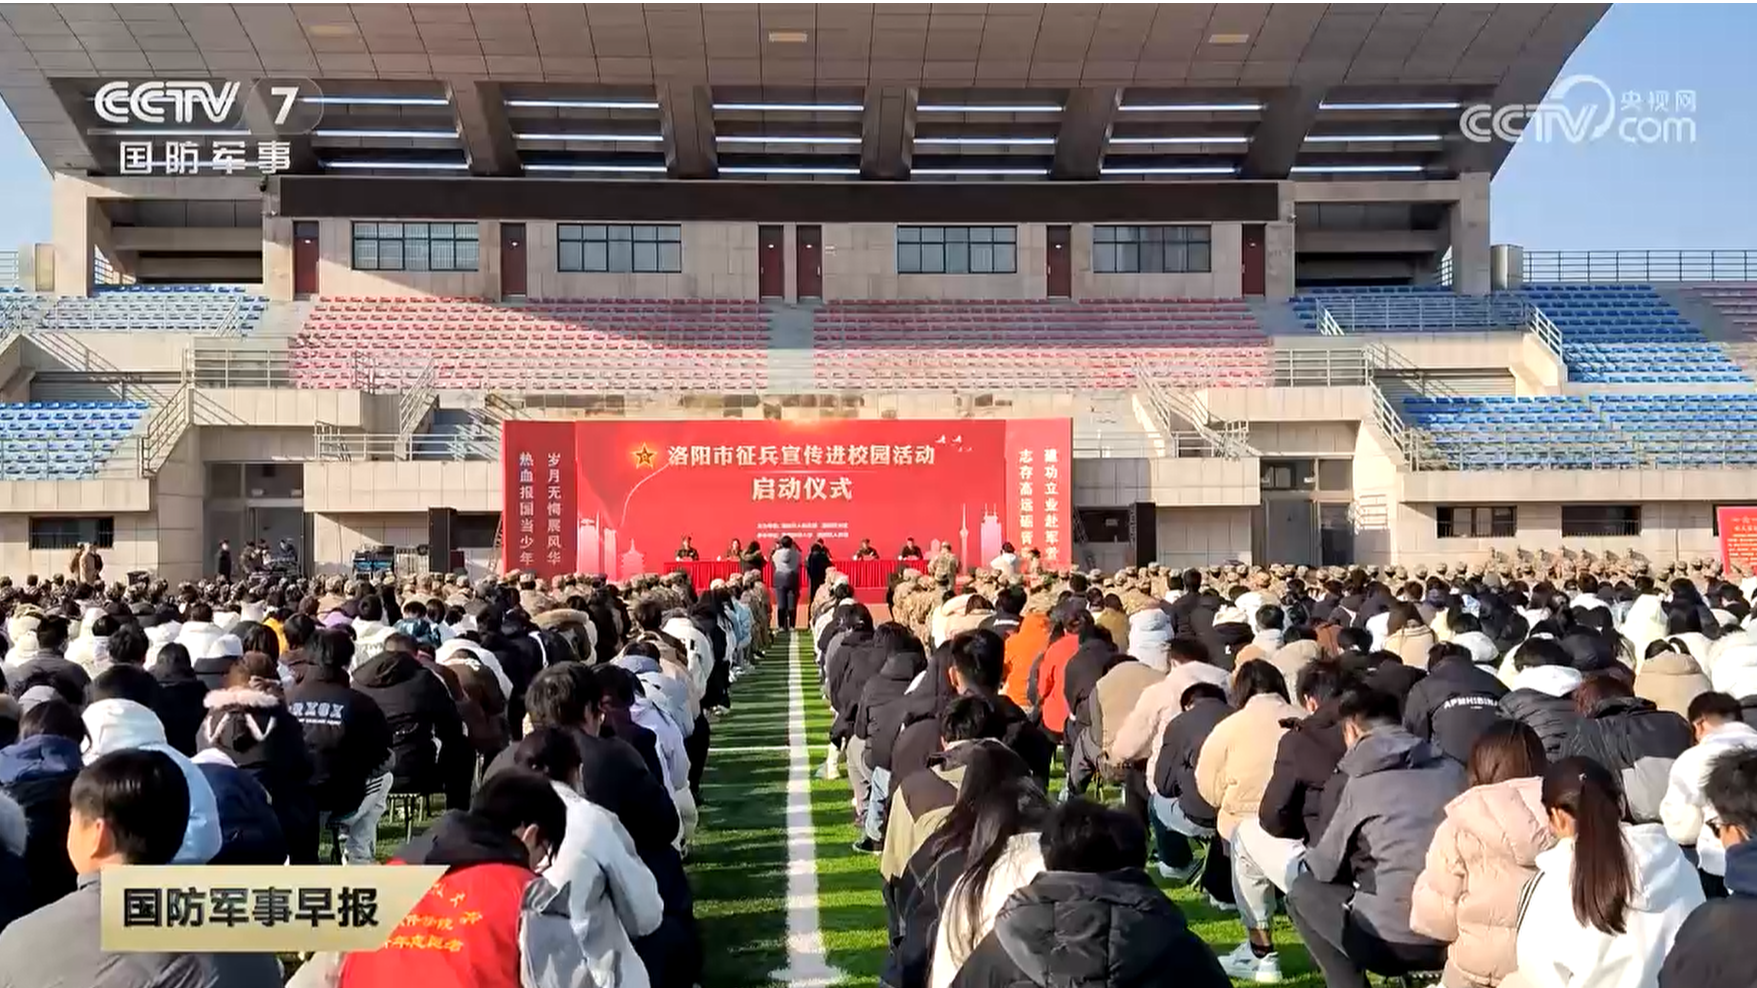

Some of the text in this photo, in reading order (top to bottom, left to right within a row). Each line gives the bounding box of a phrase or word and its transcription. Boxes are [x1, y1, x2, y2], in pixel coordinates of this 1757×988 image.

[668, 444, 935, 467] 洛阳市征兵宣传进校园活动
[752, 476, 853, 501] 启动仪式
[519, 450, 534, 565] 热血报国当少年
[547, 452, 562, 566] 岁月无悔展风华
